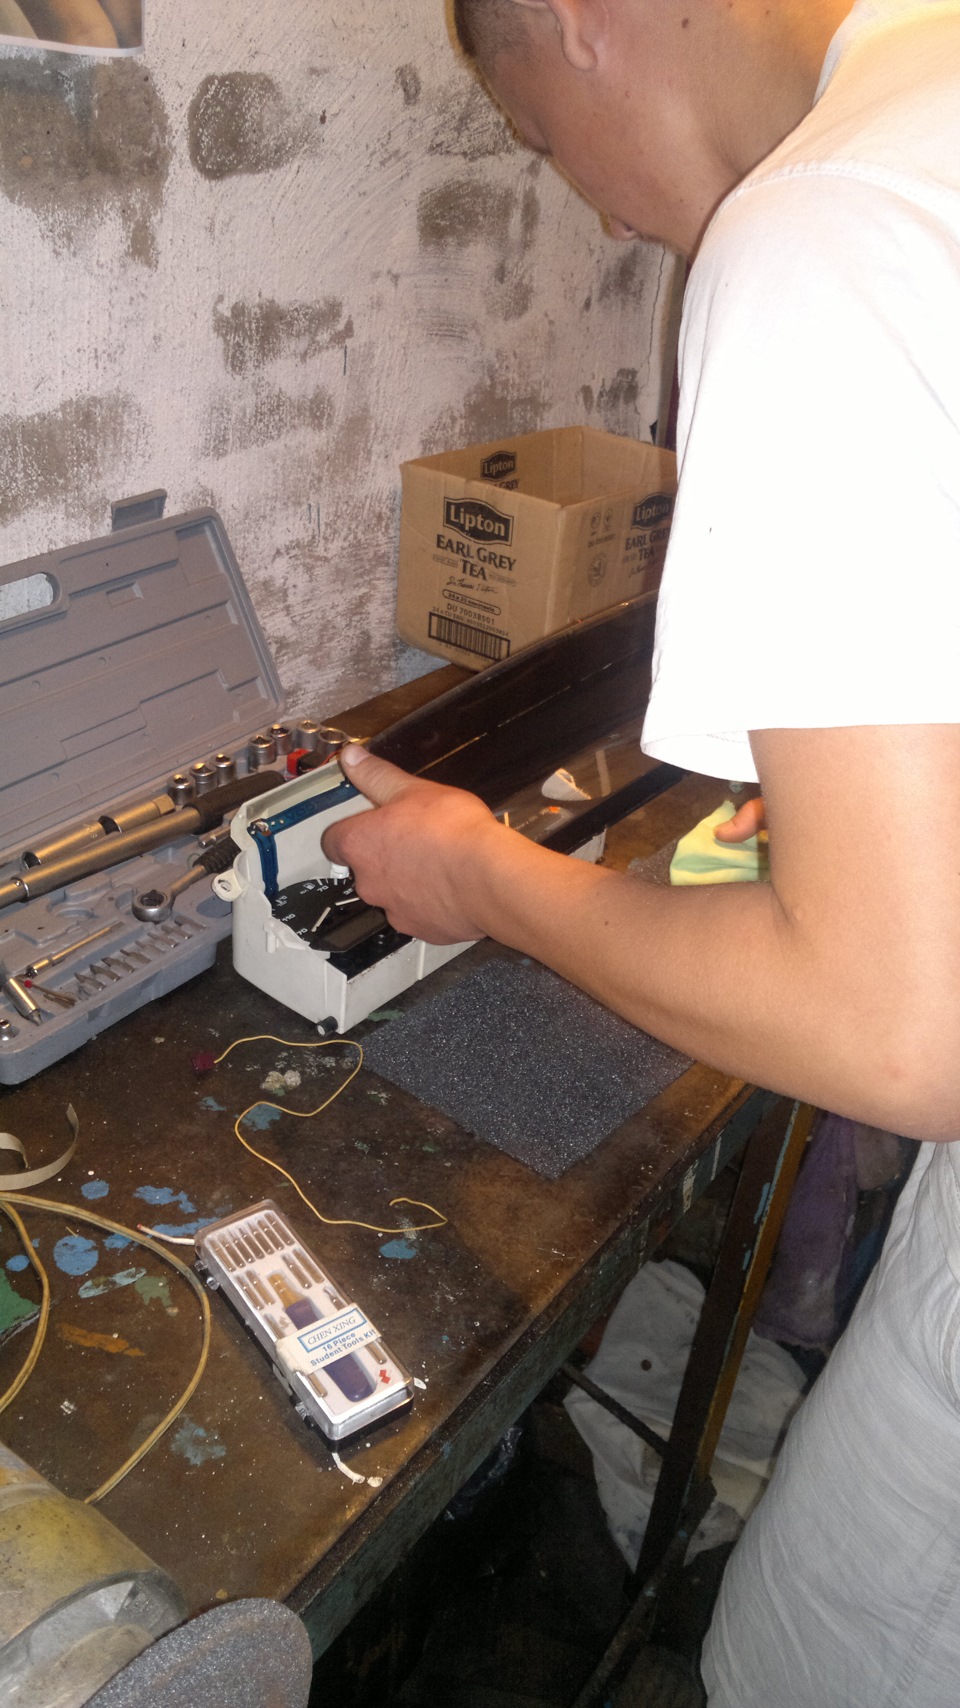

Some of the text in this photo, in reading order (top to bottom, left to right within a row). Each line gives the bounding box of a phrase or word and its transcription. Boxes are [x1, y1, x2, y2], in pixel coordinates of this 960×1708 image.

[484, 460, 514, 476] Lipton
[450, 505, 507, 537] Lipton
[436, 533, 474, 559] EARL
[476, 546, 517, 571] GREY
[625, 534, 647, 551] EARL
[460, 558, 488, 581] TEA
[446, 603, 458, 613] DU
[307, 1315, 357, 1346] CHEN XING
[322, 1332, 356, 1352] 16 Piece
[310, 1329, 377, 1367] Student Tools Kit
